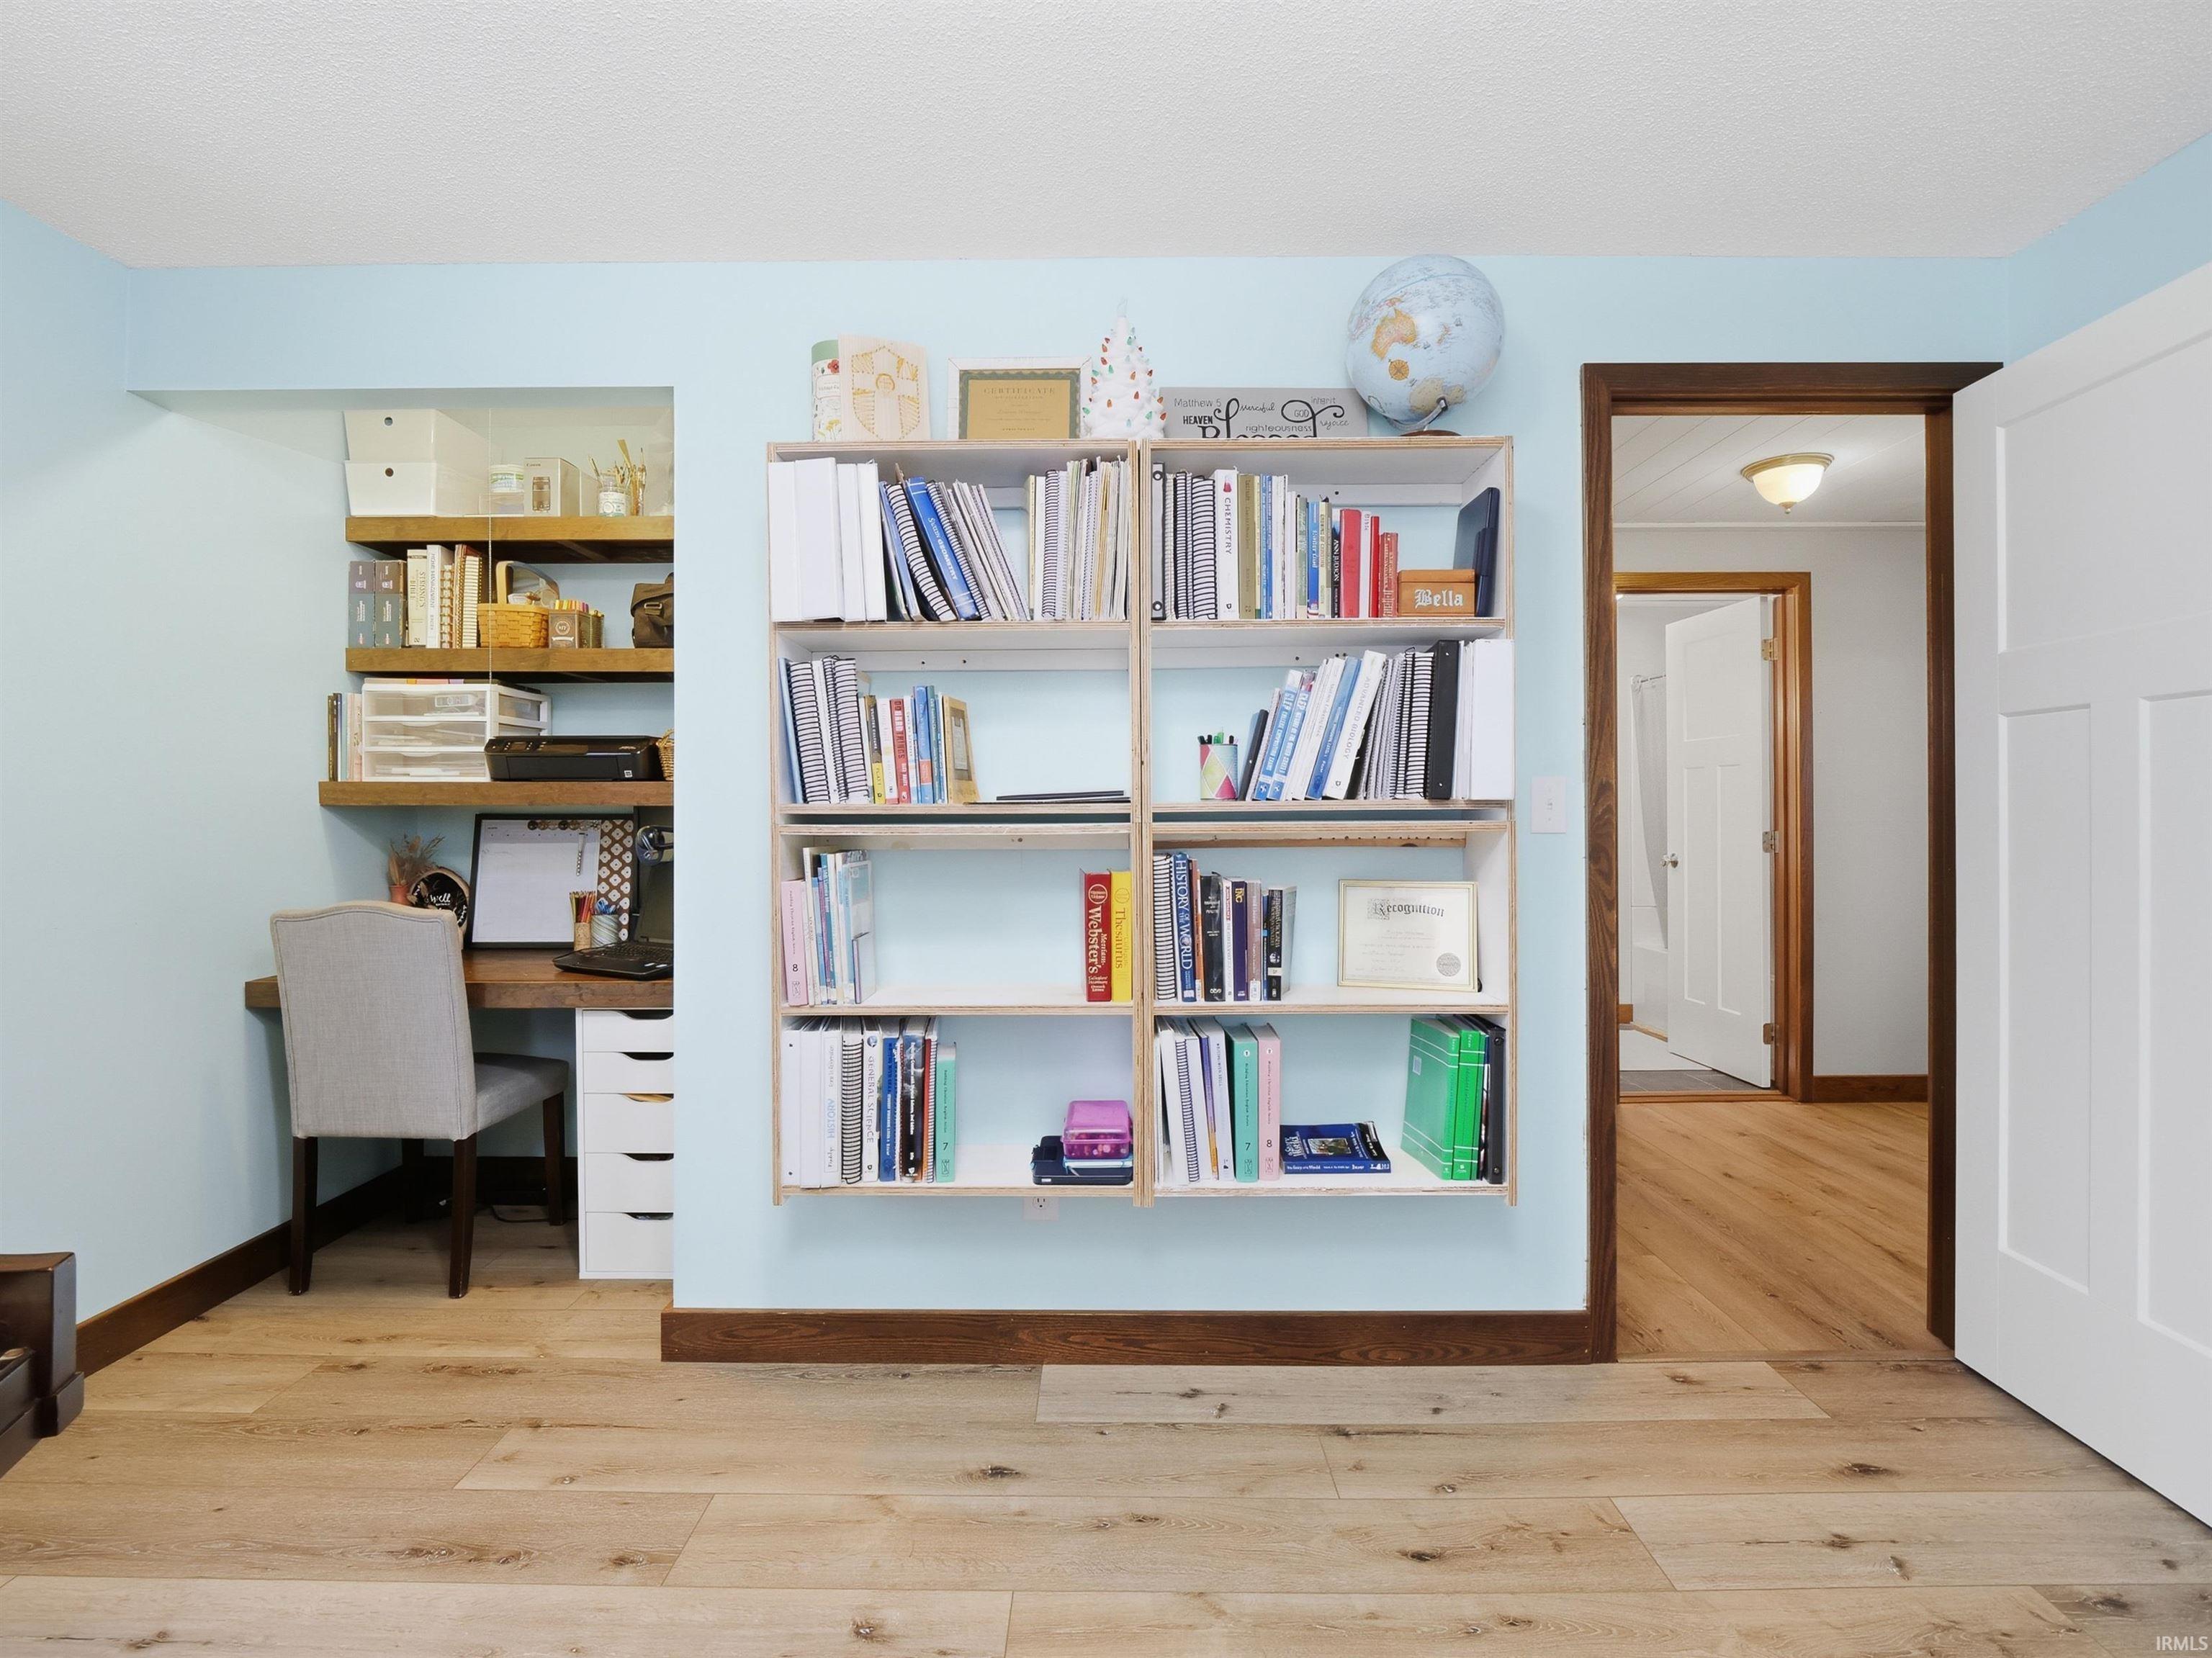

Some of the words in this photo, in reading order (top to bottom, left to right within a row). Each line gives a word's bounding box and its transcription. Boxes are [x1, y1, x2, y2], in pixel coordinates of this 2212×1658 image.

[1174, 398, 1213, 407] Matthew
[1216, 398, 1221, 407] 5
[1294, 409, 1308, 418] GOD
[1183, 415, 1213, 425] HEAVEN
[1415, 590, 1463, 609] Bella
[1298, 693, 1310, 710] CLEP
[1354, 677, 1371, 721] ADVANCED
[896, 731, 905, 759] THINGS
[1343, 724, 1359, 760] BIOLOGY
[1175, 860, 1189, 911] HISTORY
[1373, 901, 1445, 918] Recognition
[1088, 906, 1102, 973] Webster's
[1115, 907, 1126, 969] Thesaurus
[1179, 922, 1192, 970] WORLD
[792, 963, 799, 972] 8
[867, 1055, 876, 1099] GENERAL
[867, 1102, 876, 1143] SCIENCE
[1245, 1142, 1251, 1151] 7
